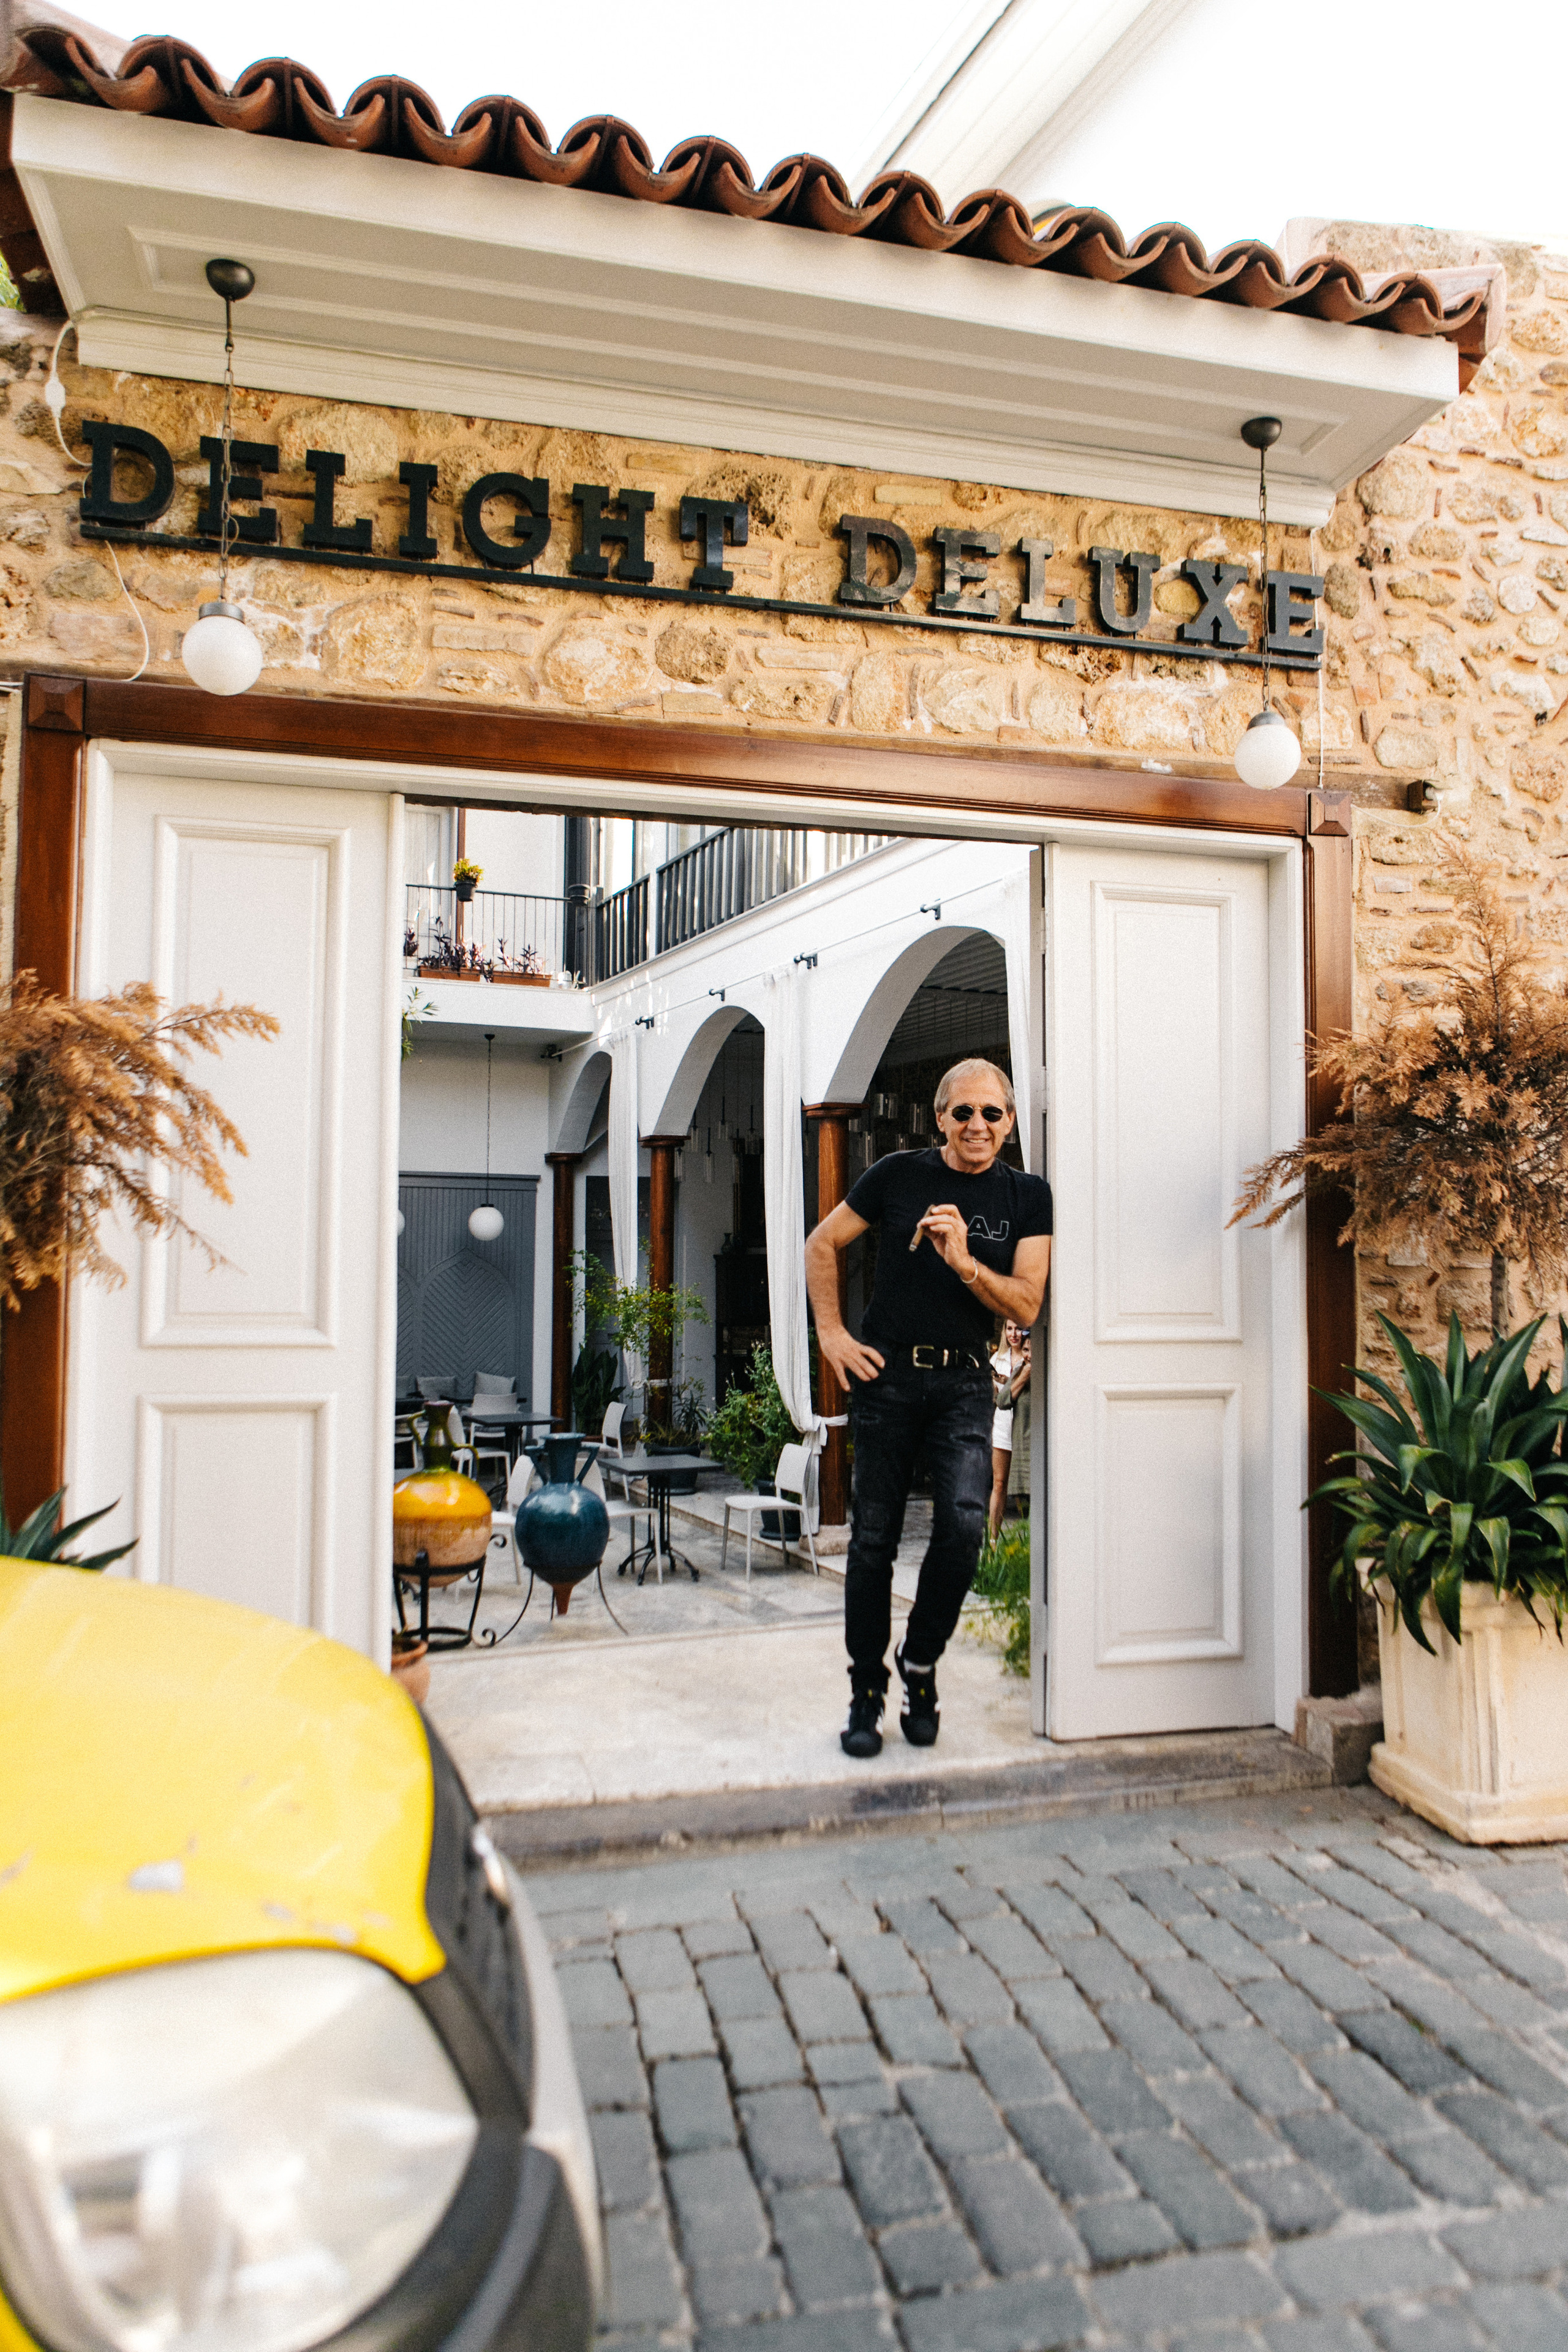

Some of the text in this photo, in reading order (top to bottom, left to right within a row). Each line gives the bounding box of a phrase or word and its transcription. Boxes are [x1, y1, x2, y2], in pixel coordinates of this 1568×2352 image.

[80, 420, 1324, 655] DELIGHT DELUXE
[967, 1215, 1009, 1241] AJ
